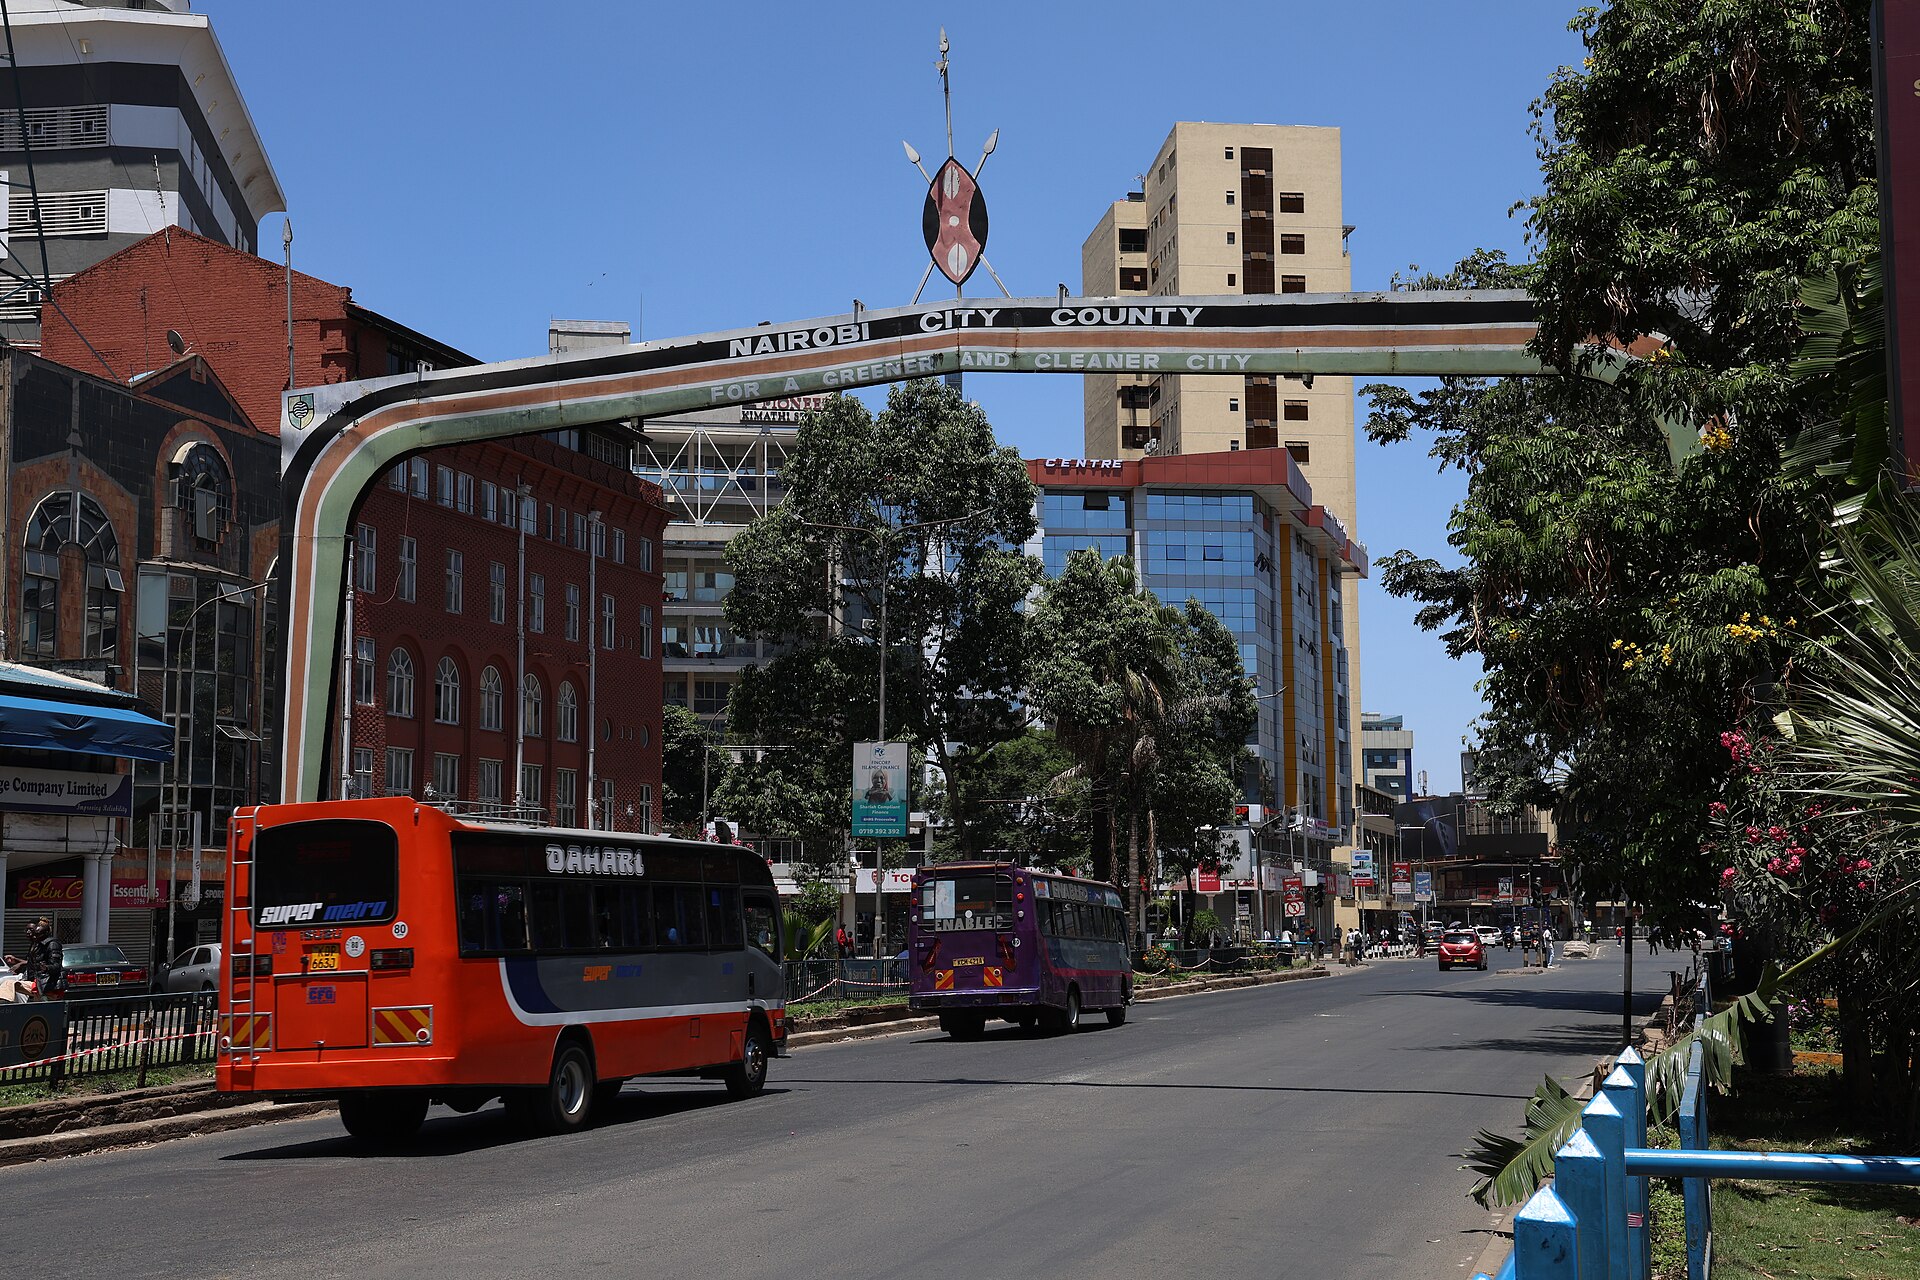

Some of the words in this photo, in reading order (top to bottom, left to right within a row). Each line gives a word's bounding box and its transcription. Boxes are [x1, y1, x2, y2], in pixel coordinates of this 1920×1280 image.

[729, 322, 870, 358] NAIROBI
[919, 309, 1001, 333] CITY
[1050, 307, 1203, 326] COUNTY
[710, 381, 761, 403] FOR
[784, 377, 800, 392] A
[822, 356, 935, 387] GREENER
[960, 351, 1010, 367] AND
[1034, 353, 1160, 370] CLEANER
[1186, 354, 1251, 370] CITY
[742, 411, 790, 421] KIMATHI
[1045, 459, 1122, 468] CENTRE
[13, 777, 65, 797] Company
[67, 781, 107, 796] Limited
[77, 804, 101, 812] Improving
[103, 805, 127, 814] Reliability
[23, 880, 65, 900] Skin
[259, 902, 323, 924] super
[323, 901, 387, 921] metro
[300, 929, 342, 941] ISUZU
[394, 925, 405, 934] 80
[312, 958, 336, 969] 663J
[583, 965, 613, 982] super
[308, 990, 333, 1000] CFG
